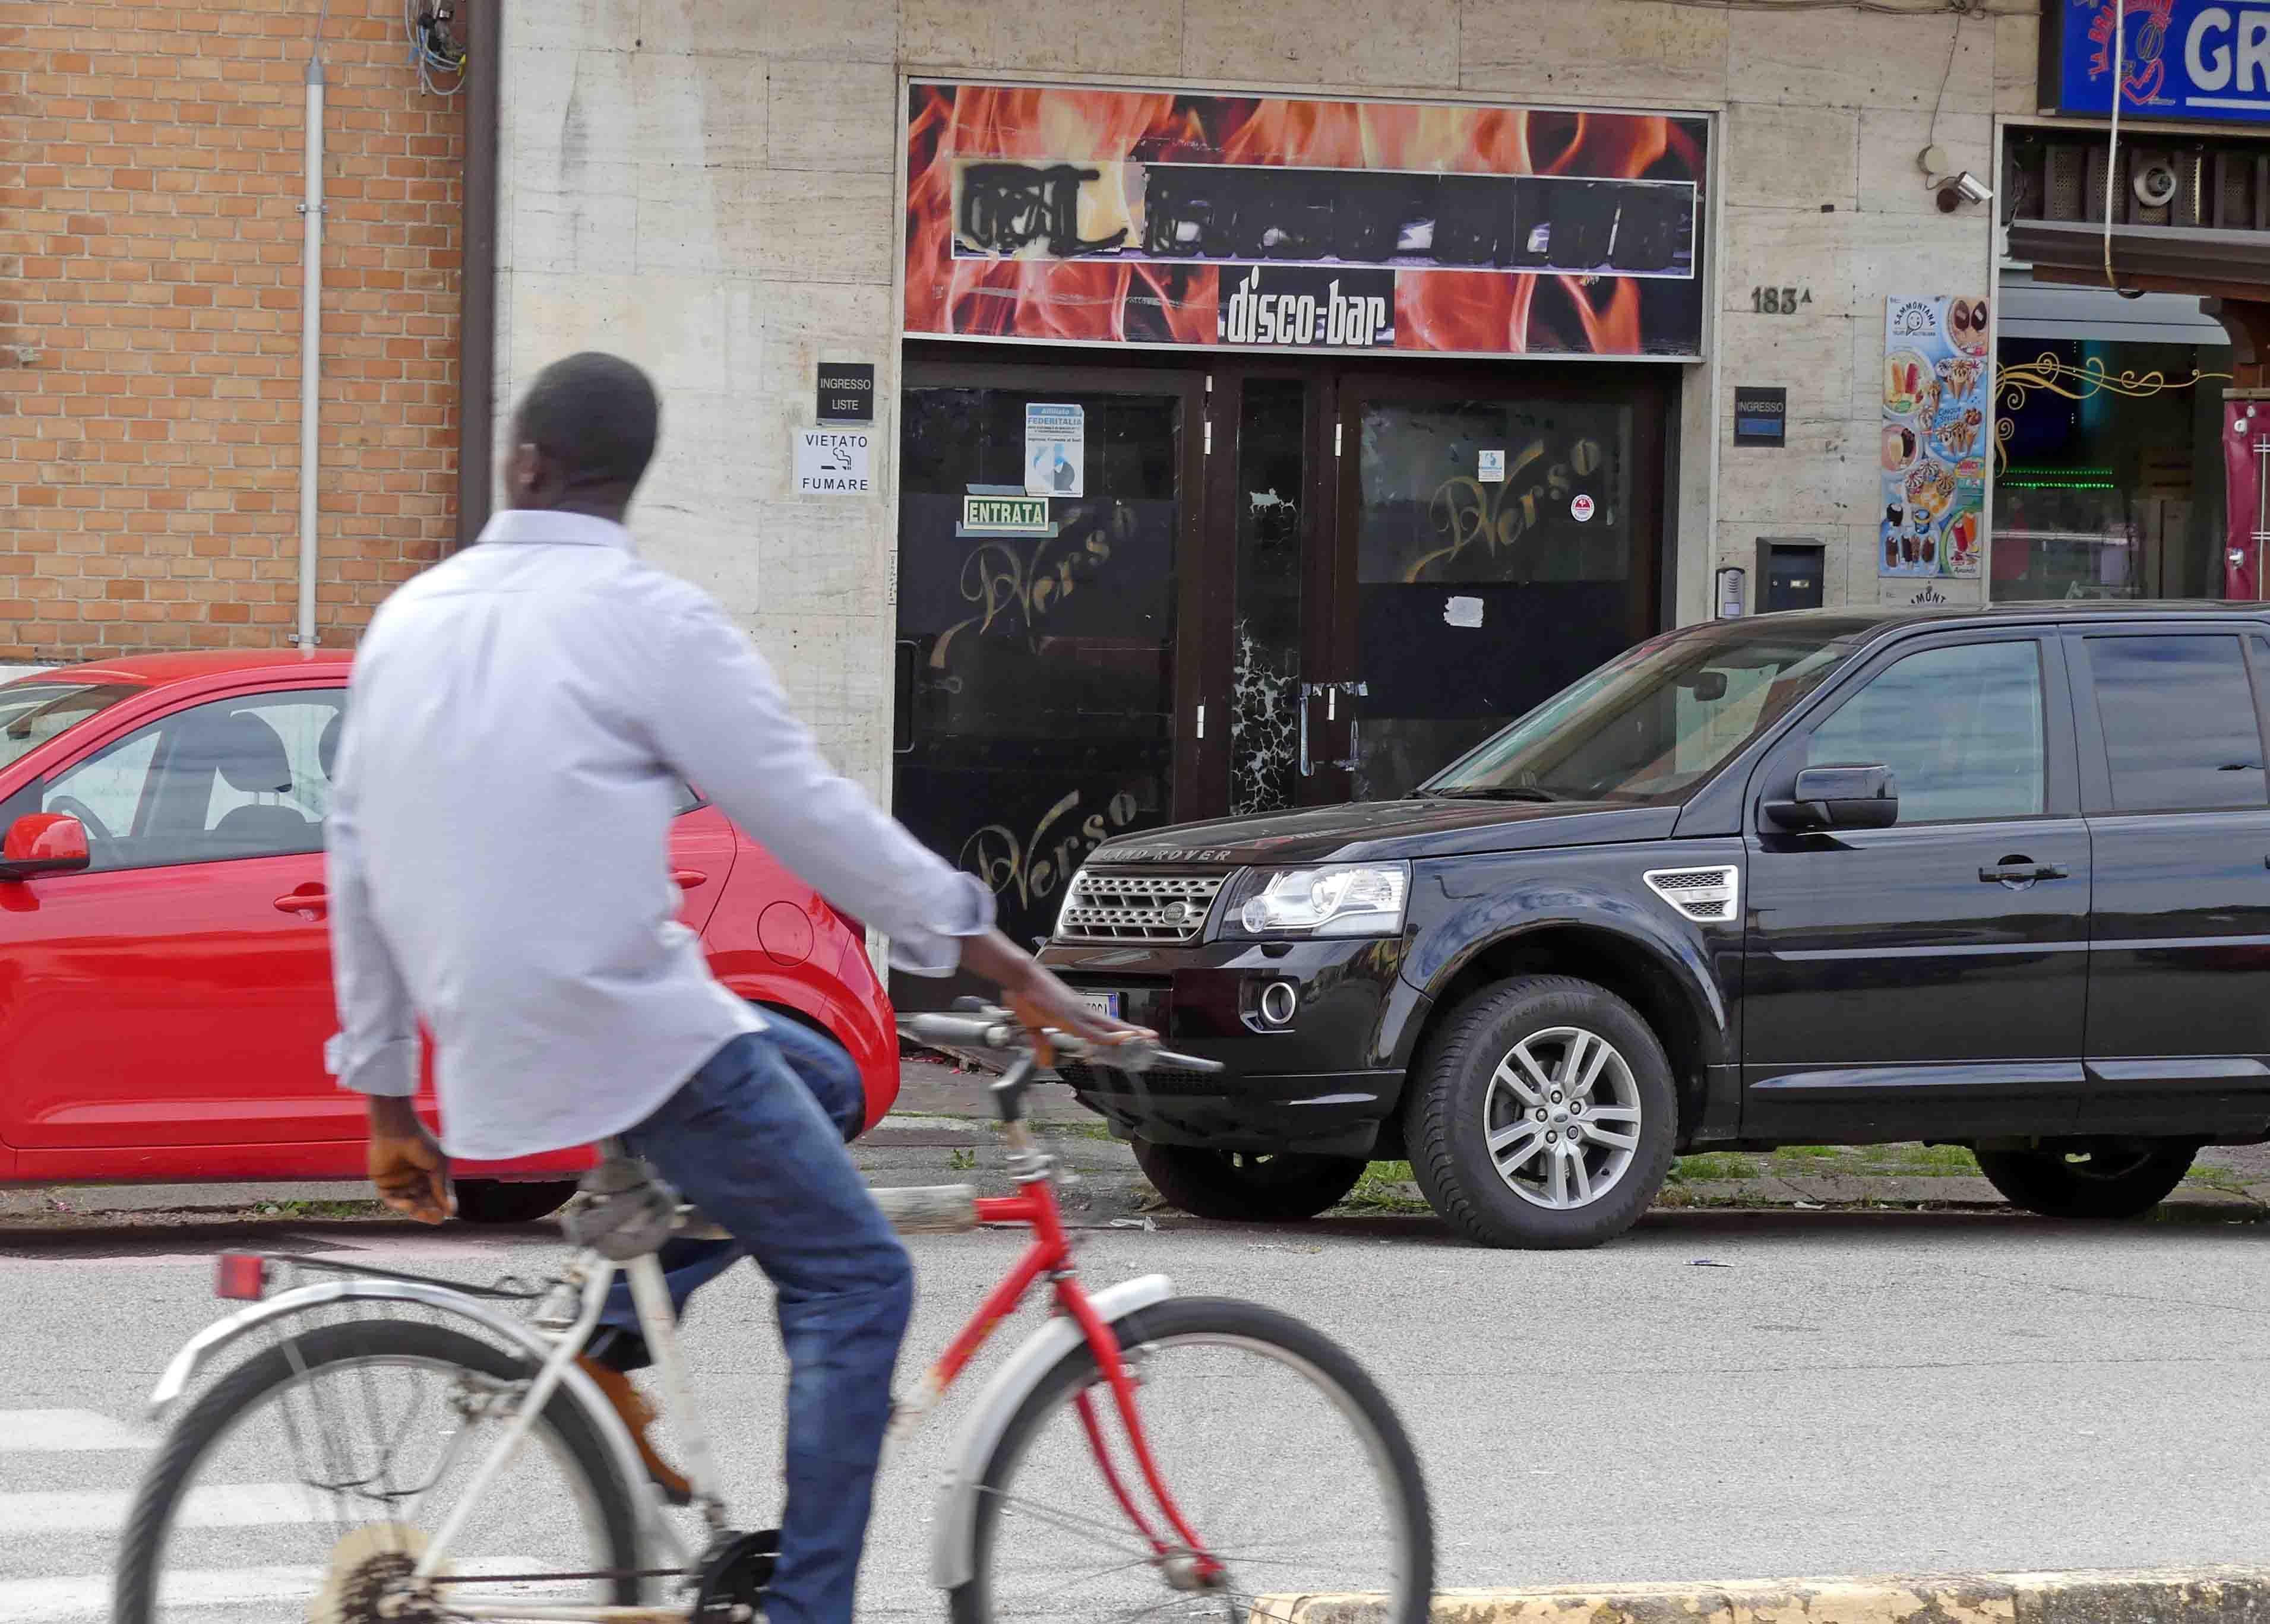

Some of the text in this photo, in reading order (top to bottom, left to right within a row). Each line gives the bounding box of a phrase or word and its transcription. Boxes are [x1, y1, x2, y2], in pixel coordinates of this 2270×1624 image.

[1227, 265, 1386, 346] disco-bar
[1894, 300, 1936, 327] SAMMONTANA
[820, 378, 871, 390] INGRESSO
[832, 399, 859, 411] LISTE
[1737, 401, 1784, 413] INGRESSO
[1027, 417, 1083, 425] FEDERITALIA
[805, 434, 868, 448] VIETATO
[802, 477, 869, 490] FUMARE
[969, 502, 1044, 524] ENTRATA
[1152, 850, 1231, 860] ROVER
